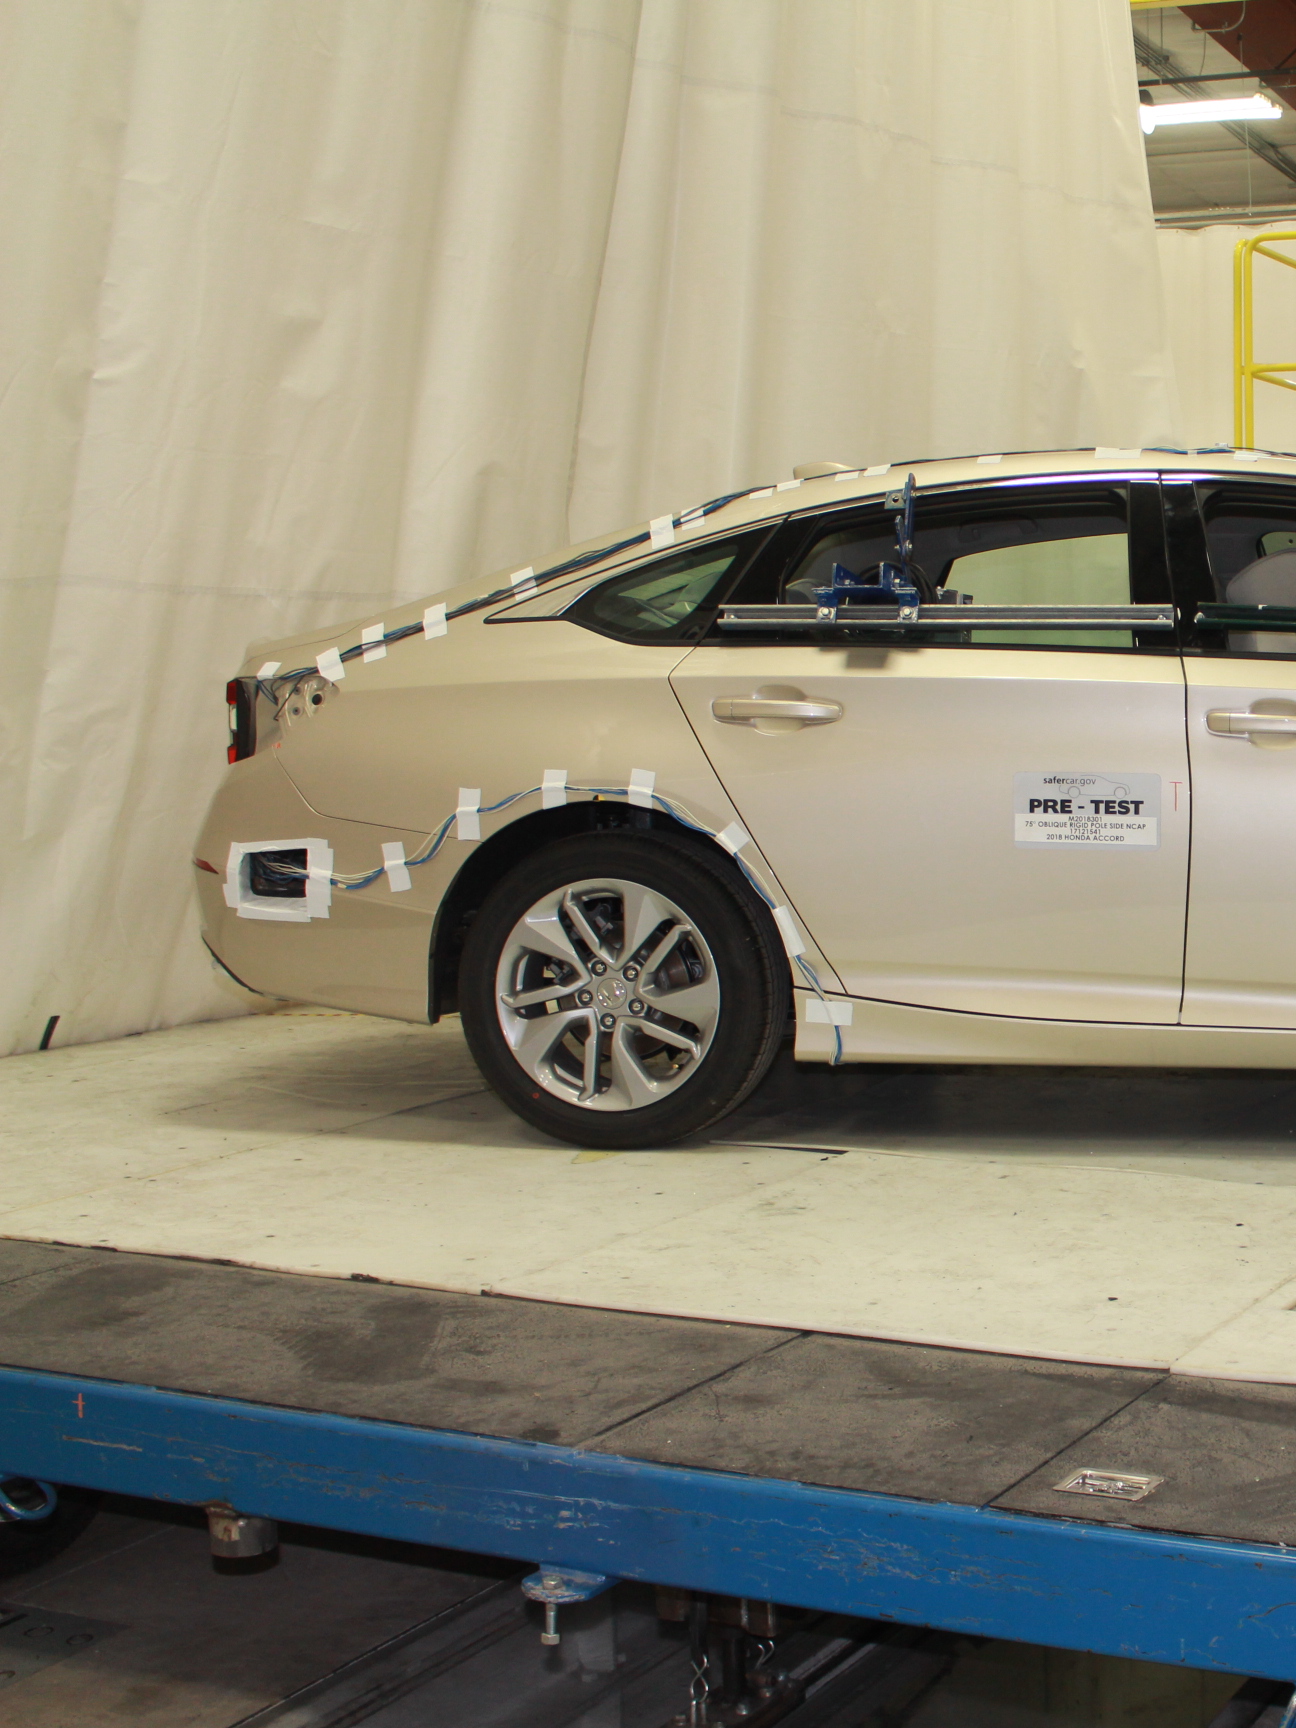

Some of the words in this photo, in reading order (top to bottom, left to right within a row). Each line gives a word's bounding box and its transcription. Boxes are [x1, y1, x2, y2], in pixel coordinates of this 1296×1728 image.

[1043, 776, 1096, 786] safercar.gov
[1029, 798, 1073, 814] PRE
[1090, 799, 1144, 815] TEST
